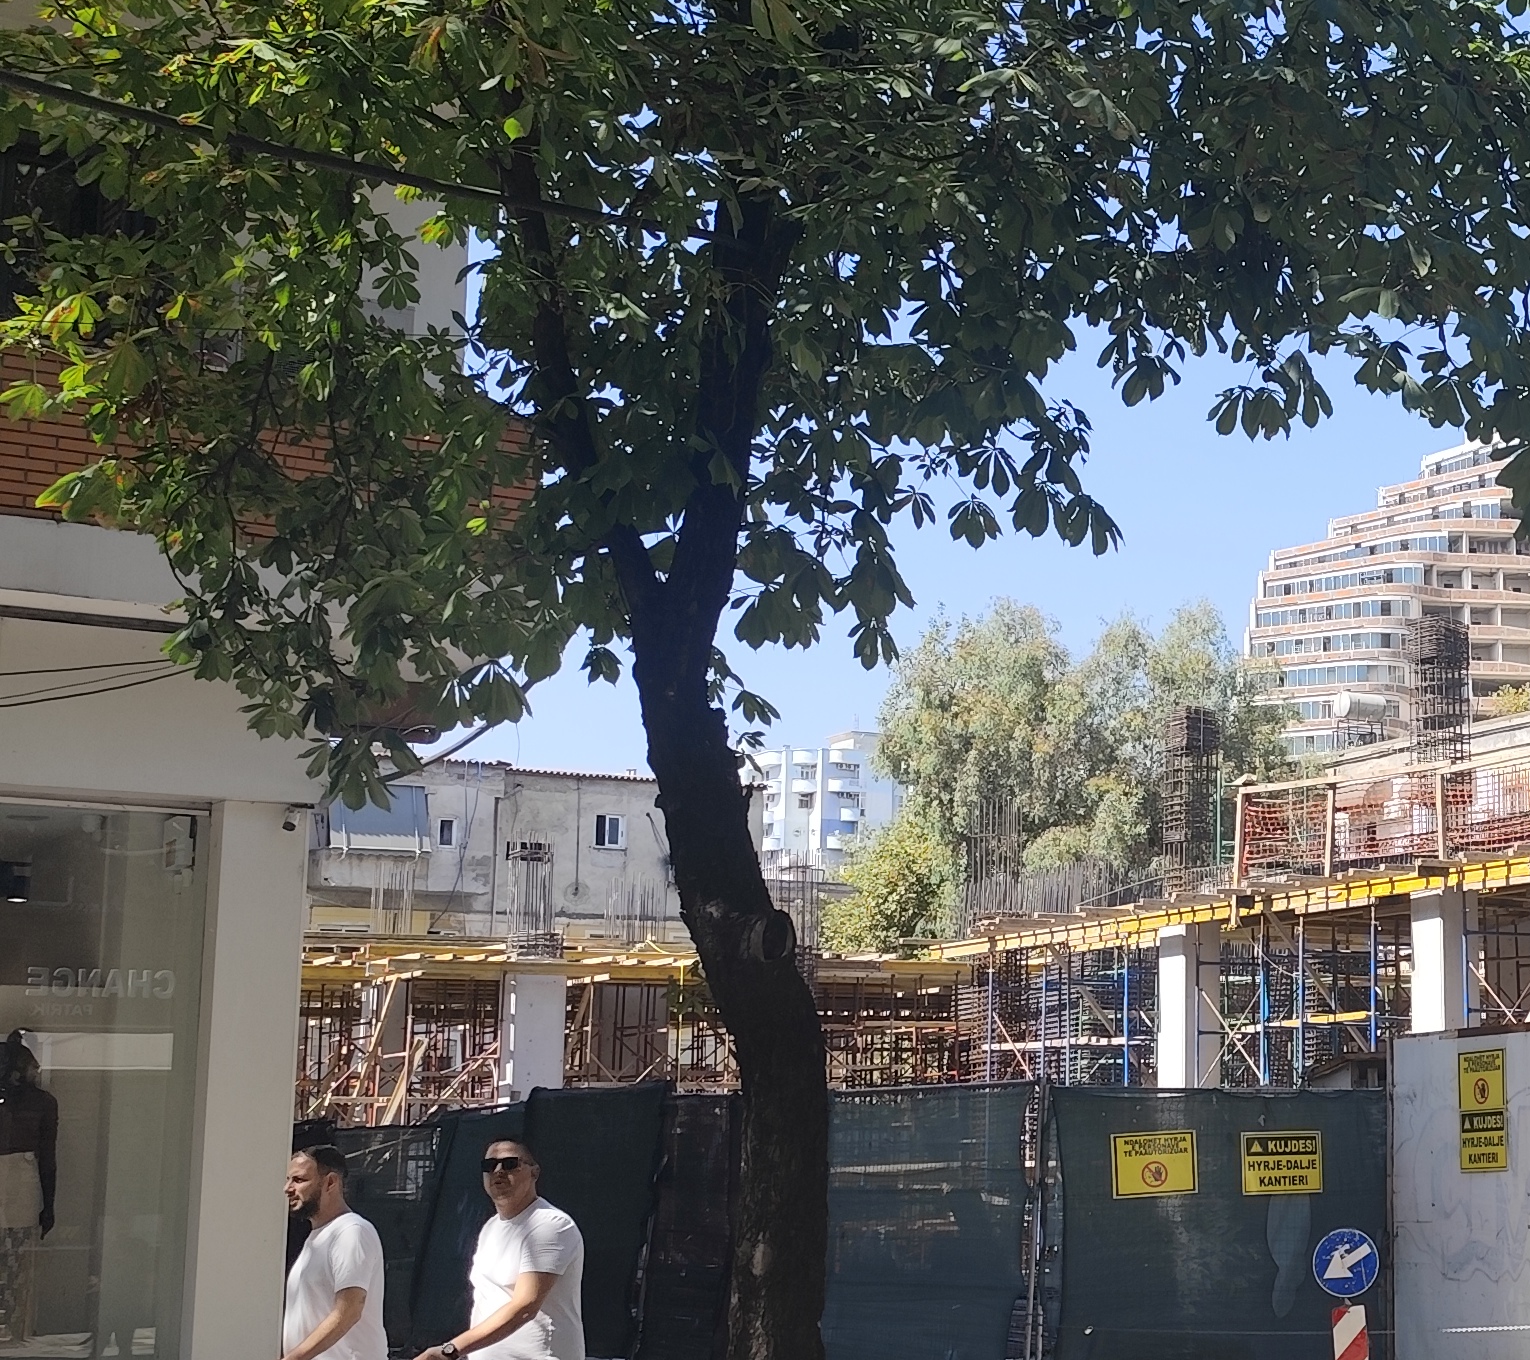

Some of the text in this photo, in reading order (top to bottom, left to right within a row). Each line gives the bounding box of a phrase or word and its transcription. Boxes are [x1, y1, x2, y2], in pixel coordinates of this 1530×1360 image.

[1473, 1115, 1503, 1129] KUJDES!
[1124, 1137, 1161, 1146] NDALOHET
[1138, 1141, 1179, 1150] PERSONAVE
[1267, 1139, 1316, 1153] KUJDES!
[1462, 1135, 1504, 1148] HYRJE-DALJE
[1468, 1152, 1498, 1164] KANTIERI
[1247, 1158, 1317, 1171] HYRJE-DALJE
[1258, 1175, 1308, 1187] KANTIERI
